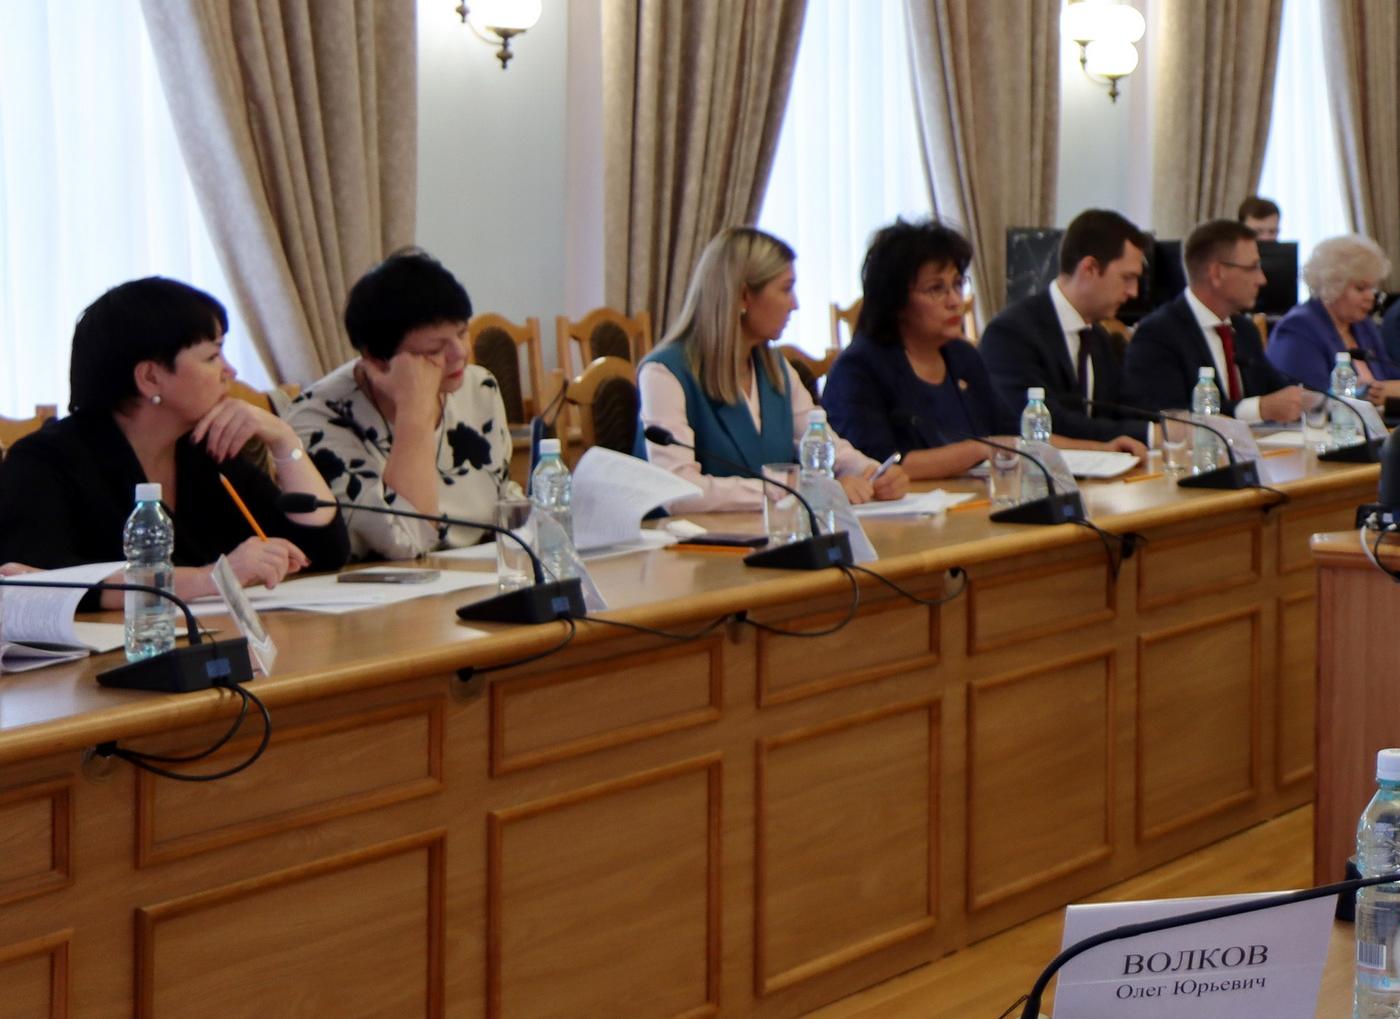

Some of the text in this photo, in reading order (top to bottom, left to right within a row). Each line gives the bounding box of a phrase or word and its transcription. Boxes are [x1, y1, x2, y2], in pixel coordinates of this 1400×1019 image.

[1122, 944, 1269, 976] ВОЛКОВ
[1116, 976, 1267, 999] Олег Юрьевич
